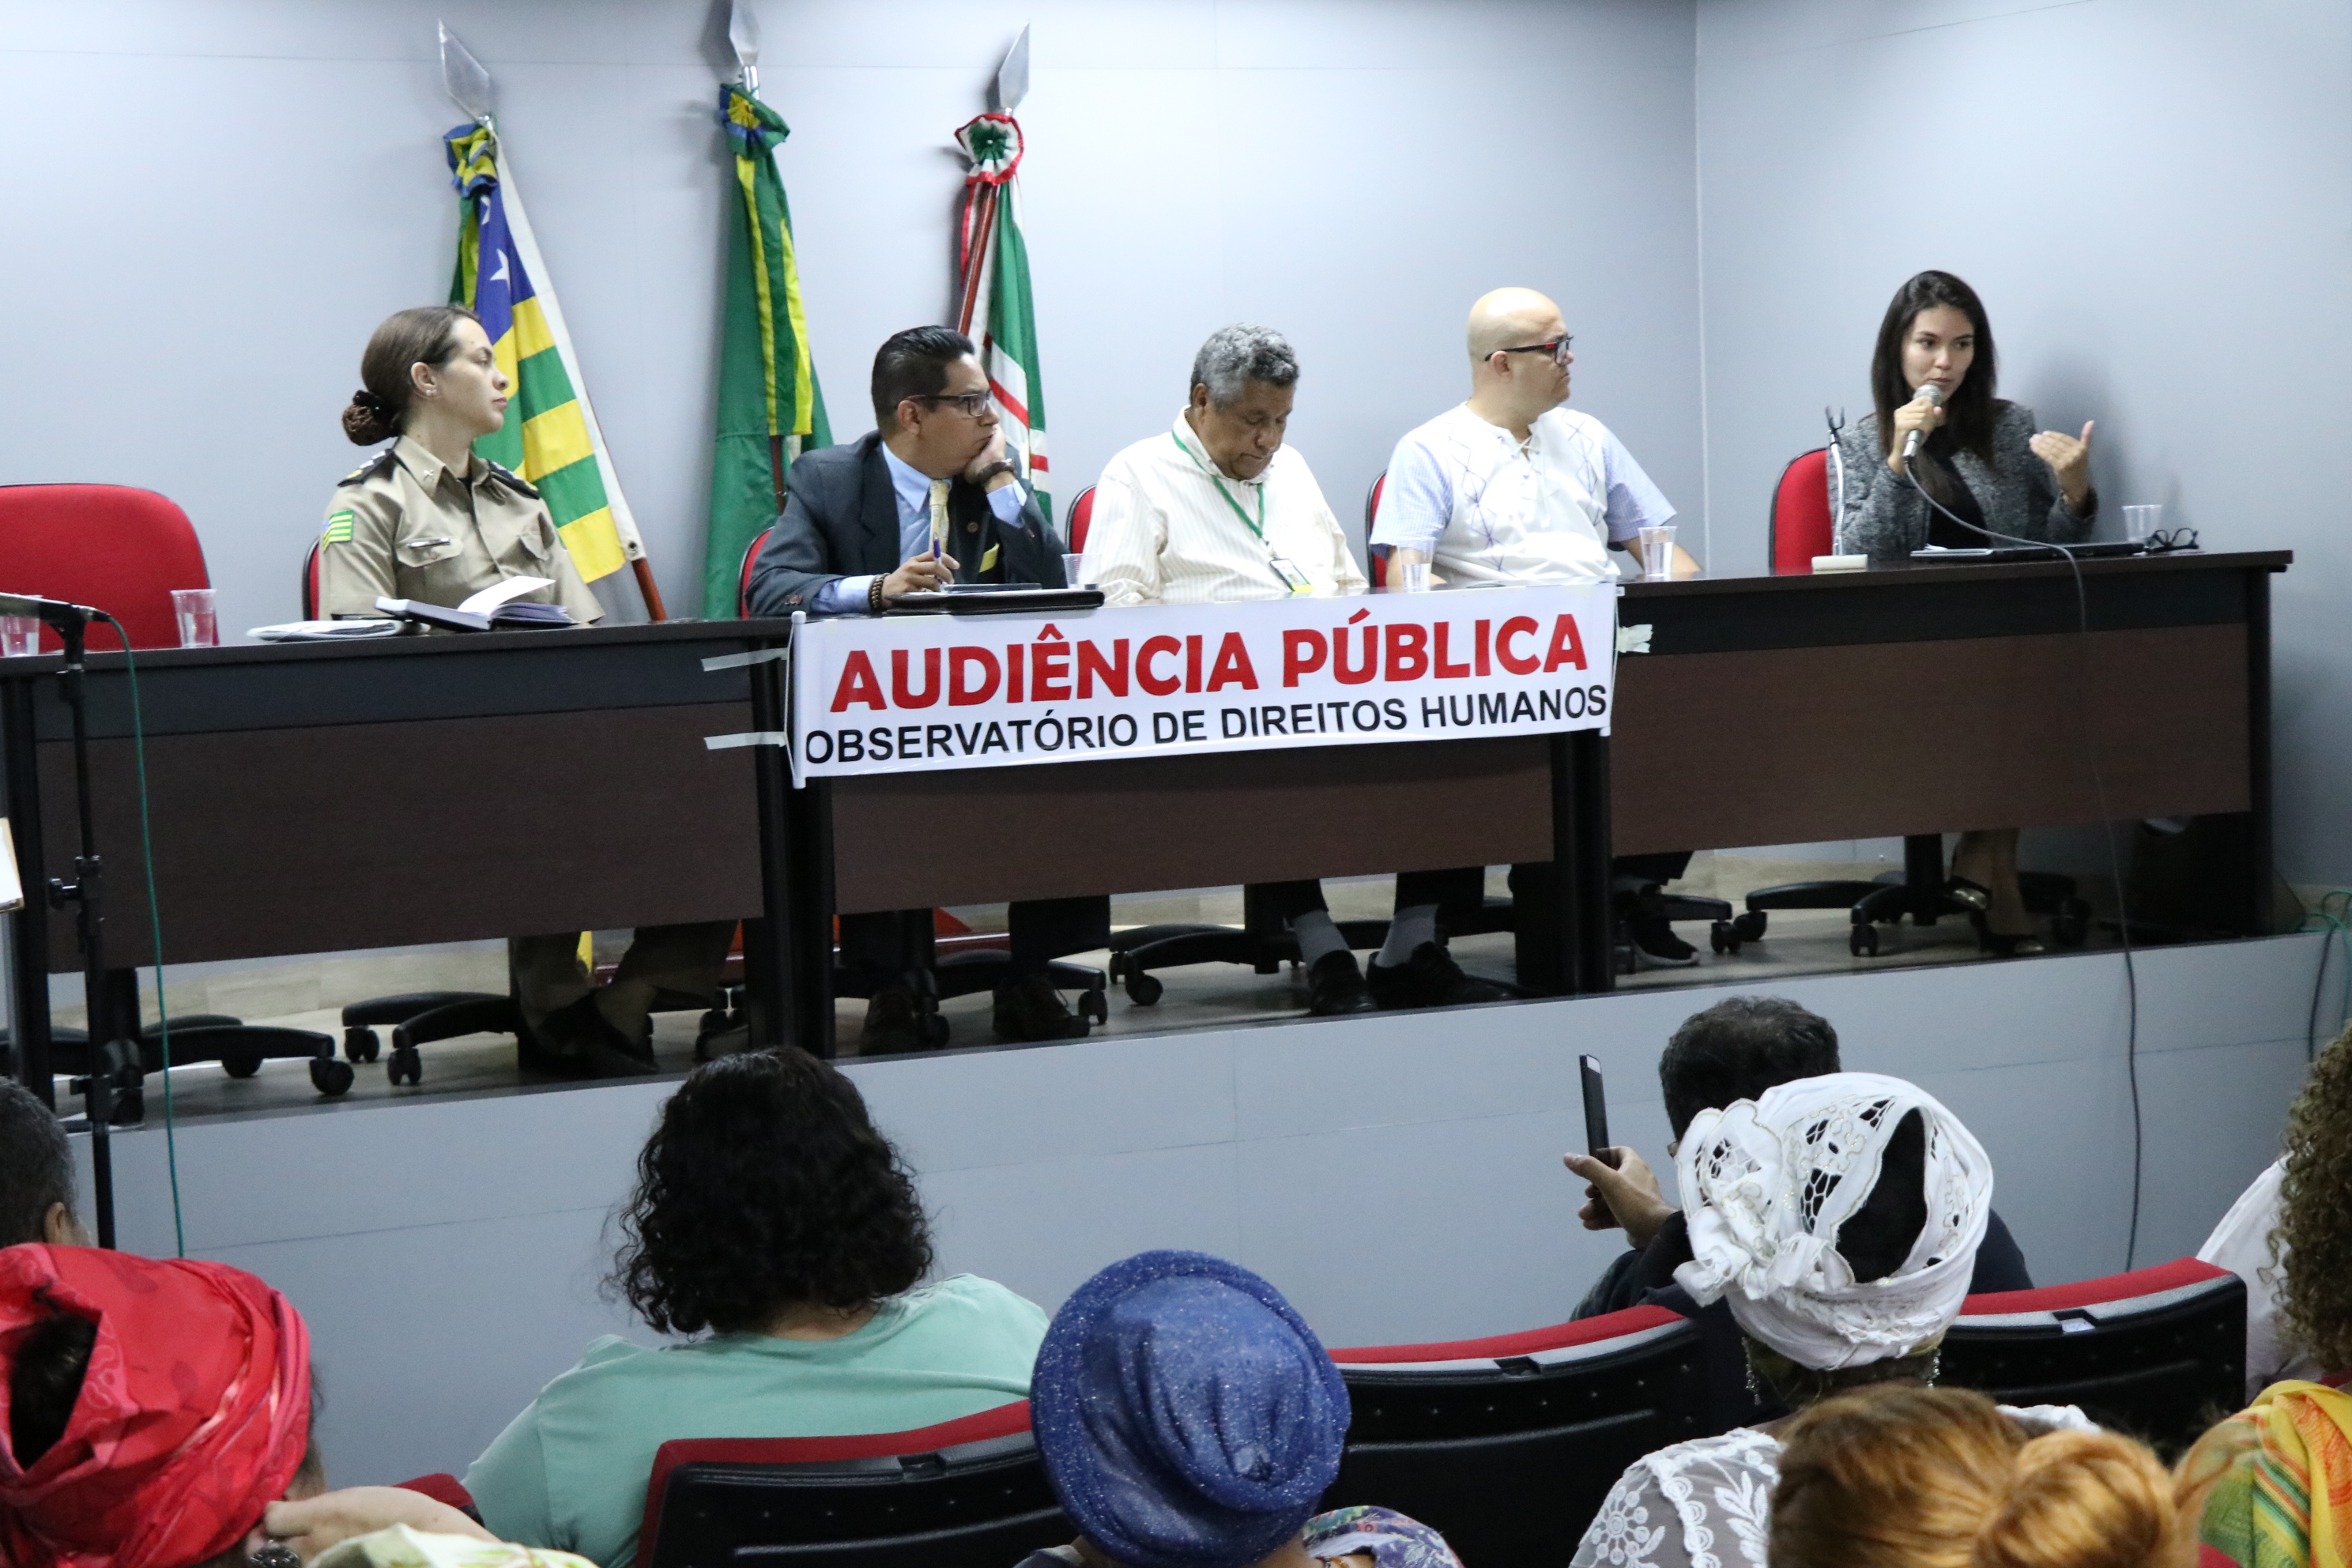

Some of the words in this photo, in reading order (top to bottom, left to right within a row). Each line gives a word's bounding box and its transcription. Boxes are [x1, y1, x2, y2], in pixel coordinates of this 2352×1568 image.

[830, 622, 1260, 714] AUDIÊNCIA
[1282, 607, 1589, 688] PÚBLICA
[805, 707, 1138, 765] OBSERVATÓRIO
[1152, 710, 1208, 744] DE
[1220, 697, 1408, 740] DIREITOS
[1420, 684, 1608, 729] HUMANOS
